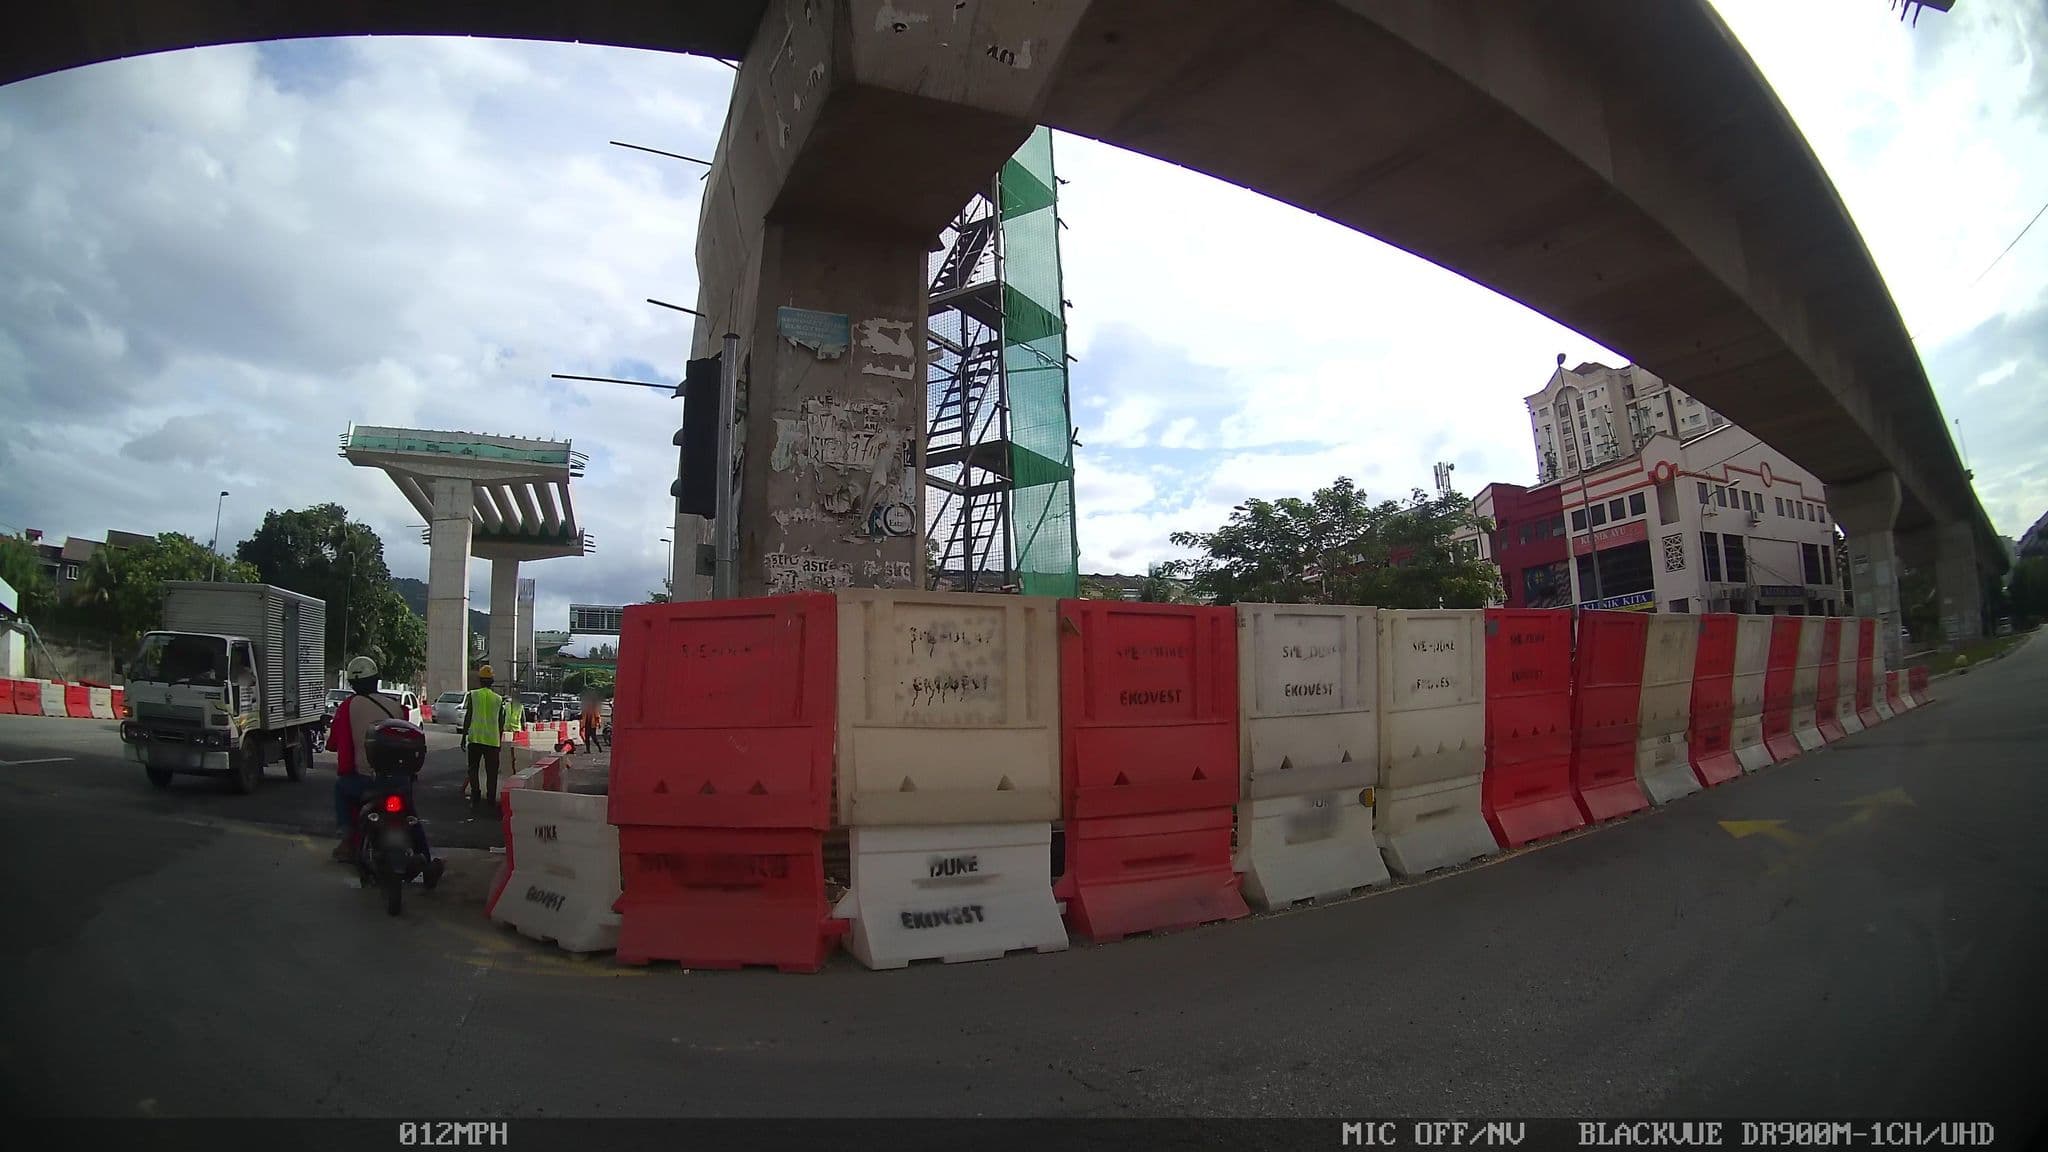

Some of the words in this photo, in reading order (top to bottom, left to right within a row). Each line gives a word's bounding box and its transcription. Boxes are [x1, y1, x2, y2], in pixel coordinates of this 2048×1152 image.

[1581, 530, 1608, 545] KLNIK
[1623, 594, 1648, 606] KITA
[1120, 689, 1183, 705] EKOVEST
[1285, 683, 1333, 697] EKOVEST
[930, 856, 978, 878] DUKE
